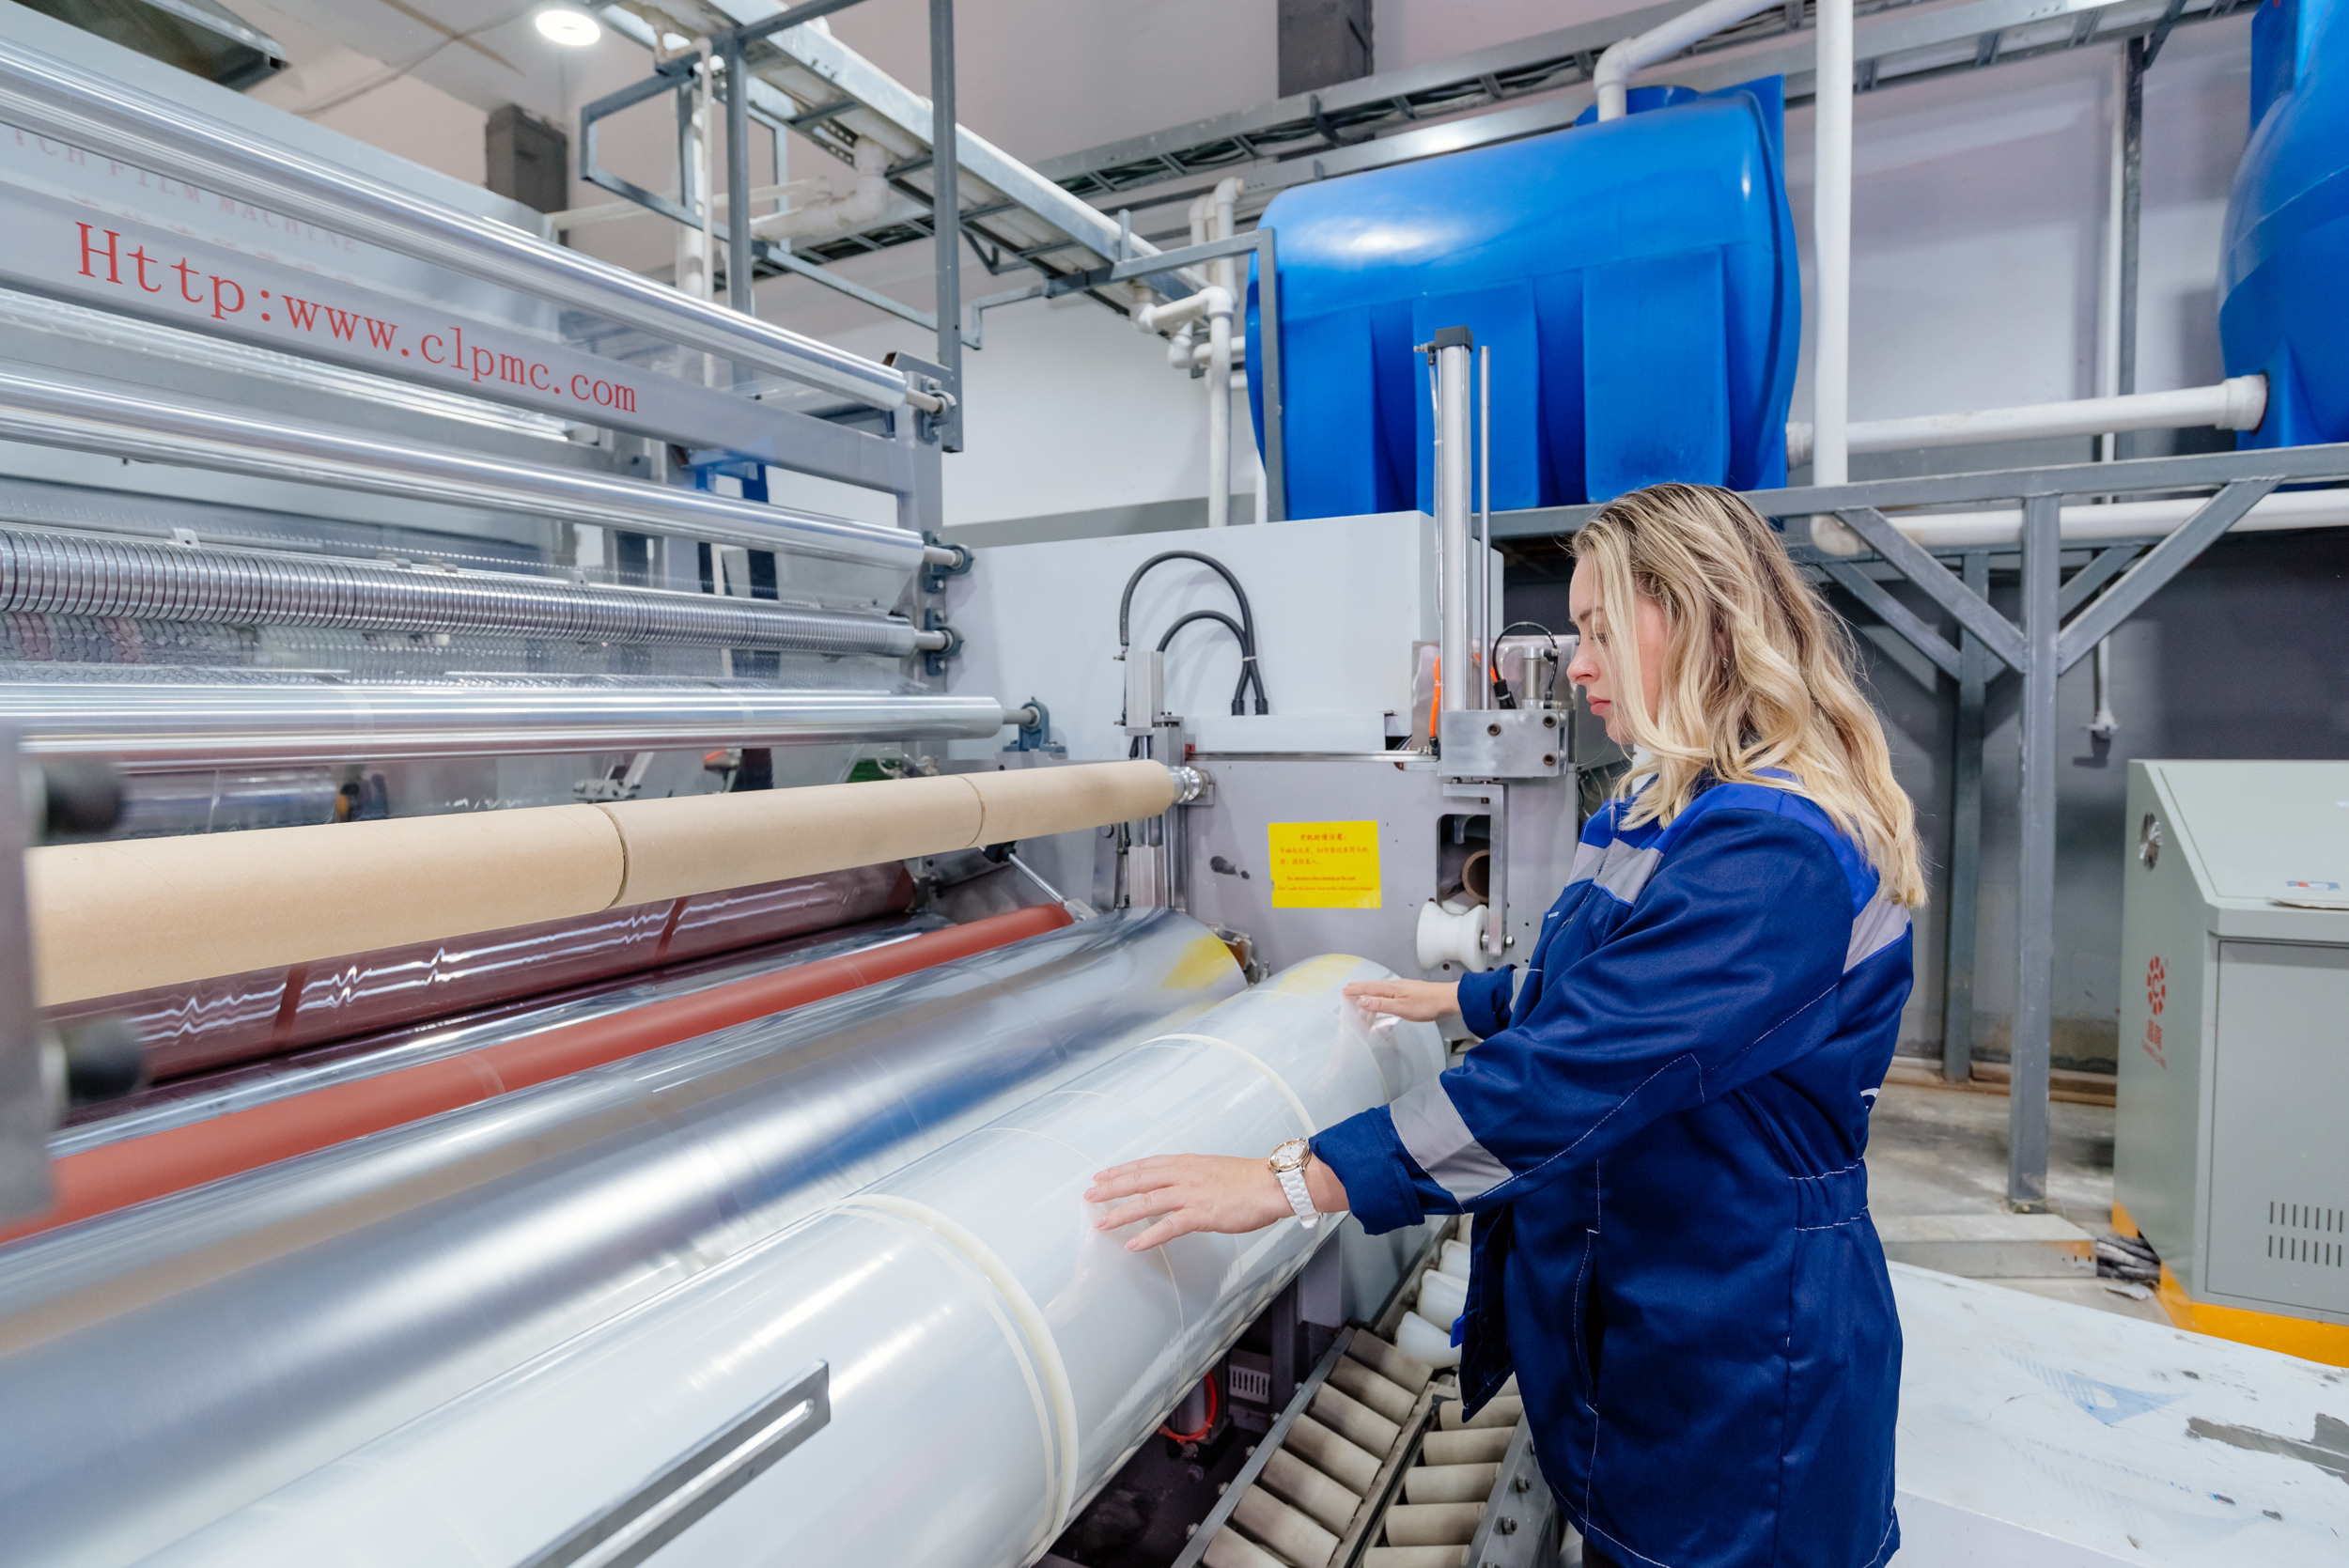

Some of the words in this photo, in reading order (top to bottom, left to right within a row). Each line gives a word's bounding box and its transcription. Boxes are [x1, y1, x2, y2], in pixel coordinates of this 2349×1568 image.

[110, 160, 200, 203] FILM
[219, 195, 358, 254] MACHINE
[75, 222, 637, 413] Http:www.clpmc.com
